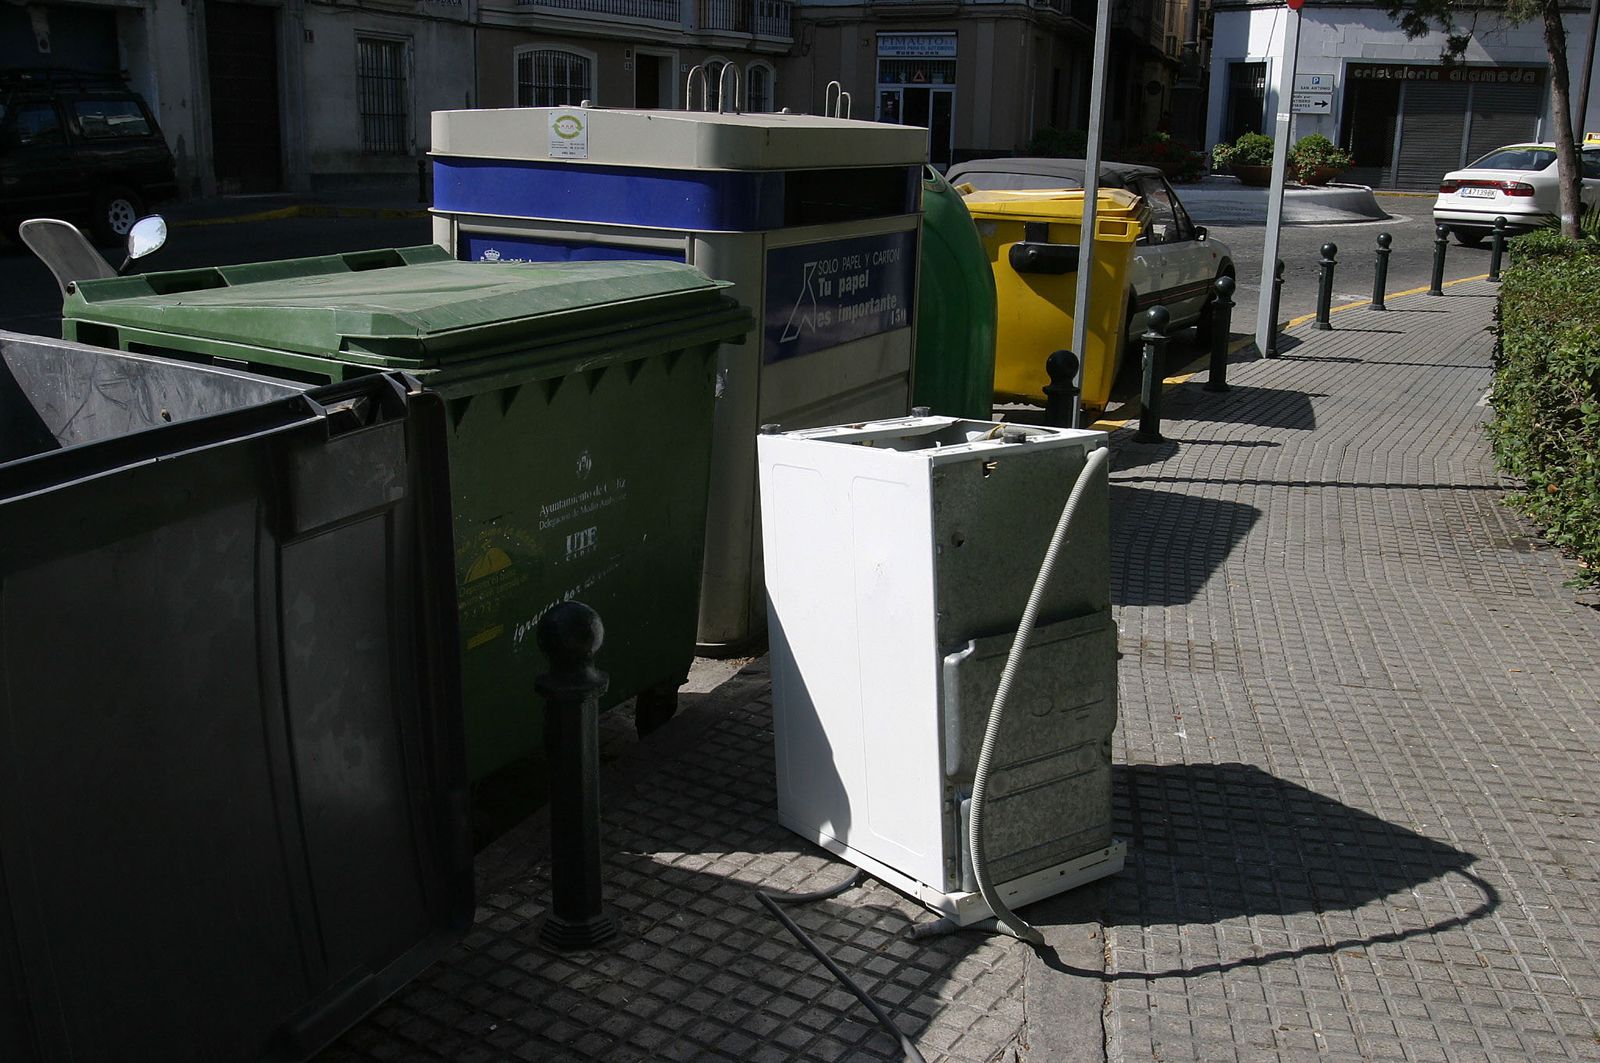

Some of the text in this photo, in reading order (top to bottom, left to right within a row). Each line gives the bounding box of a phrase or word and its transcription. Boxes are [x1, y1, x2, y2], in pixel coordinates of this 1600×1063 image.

[818, 247, 901, 276] SOLO PAPEL Y CARTON
[818, 269, 870, 299] Tu papel
[817, 294, 897, 328] es importante
[539, 488, 592, 518] Ayuntamiento
[566, 526, 598, 554] UTE
